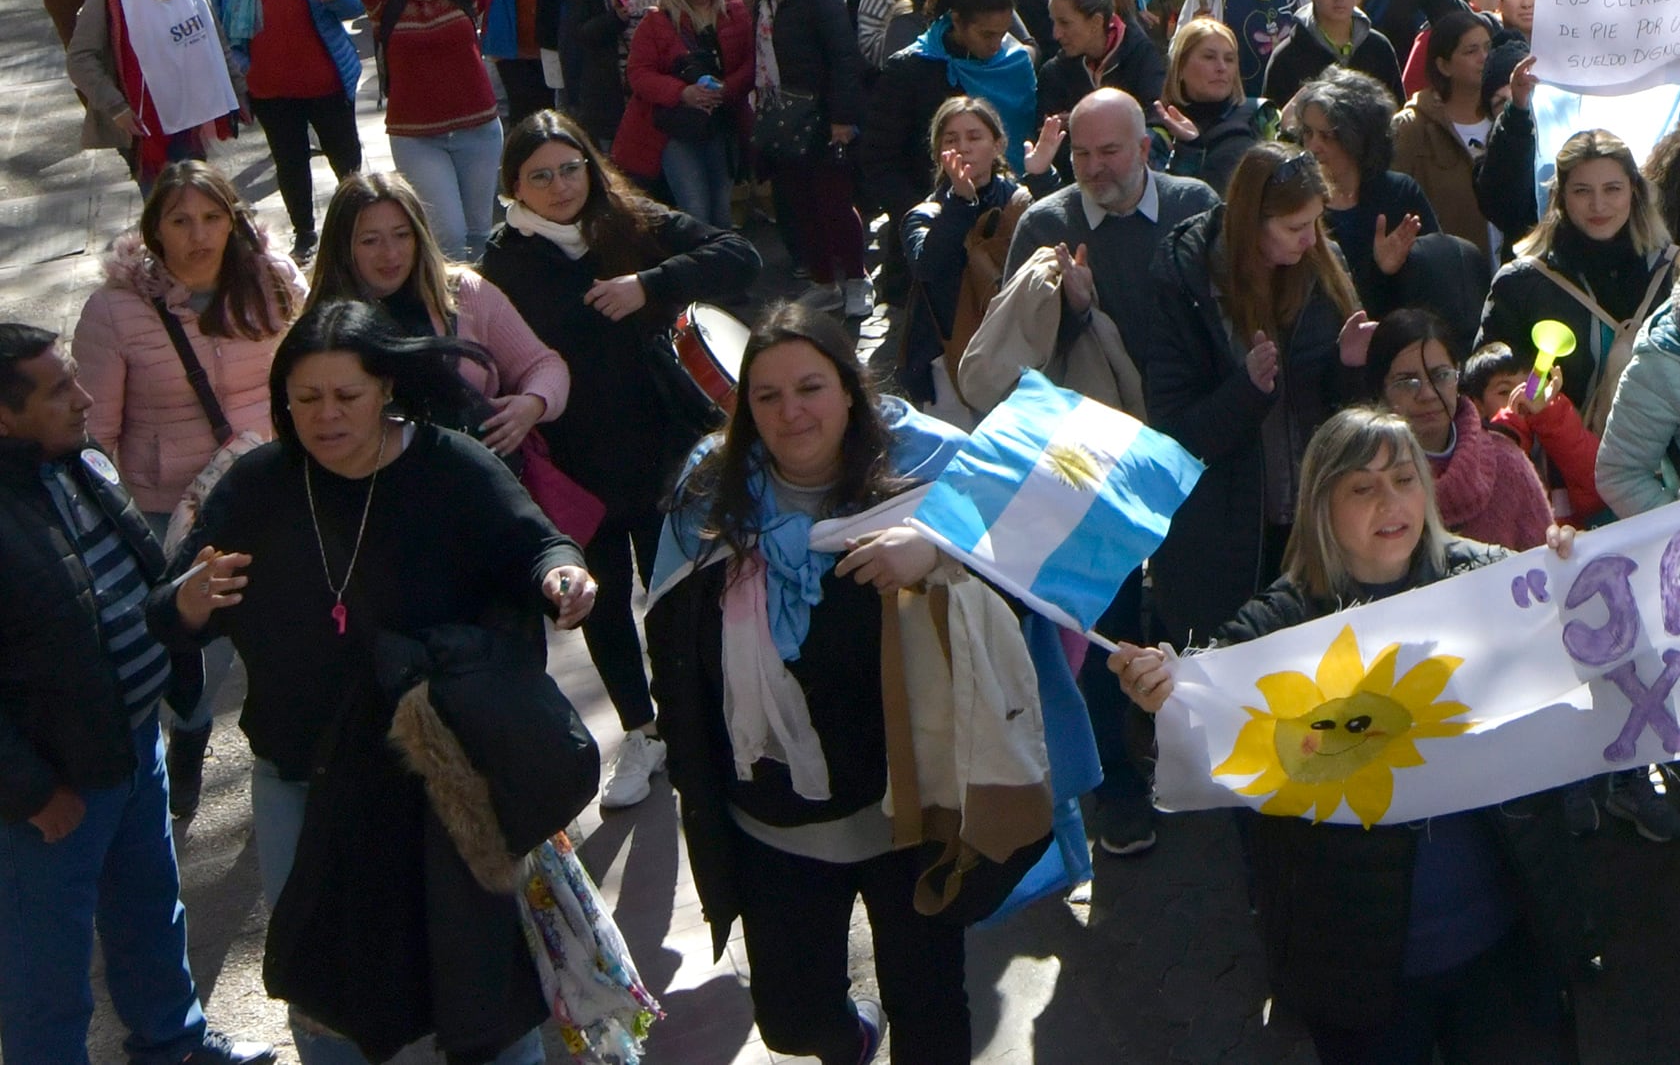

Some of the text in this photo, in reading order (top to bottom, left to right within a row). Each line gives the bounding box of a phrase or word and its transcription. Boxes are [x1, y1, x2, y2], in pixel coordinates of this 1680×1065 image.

[1559, 23, 1580, 39] DE
[1590, 22, 1619, 39] PIE
[1636, 18, 1665, 39] POR
[1567, 53, 1627, 69] SUELDO
